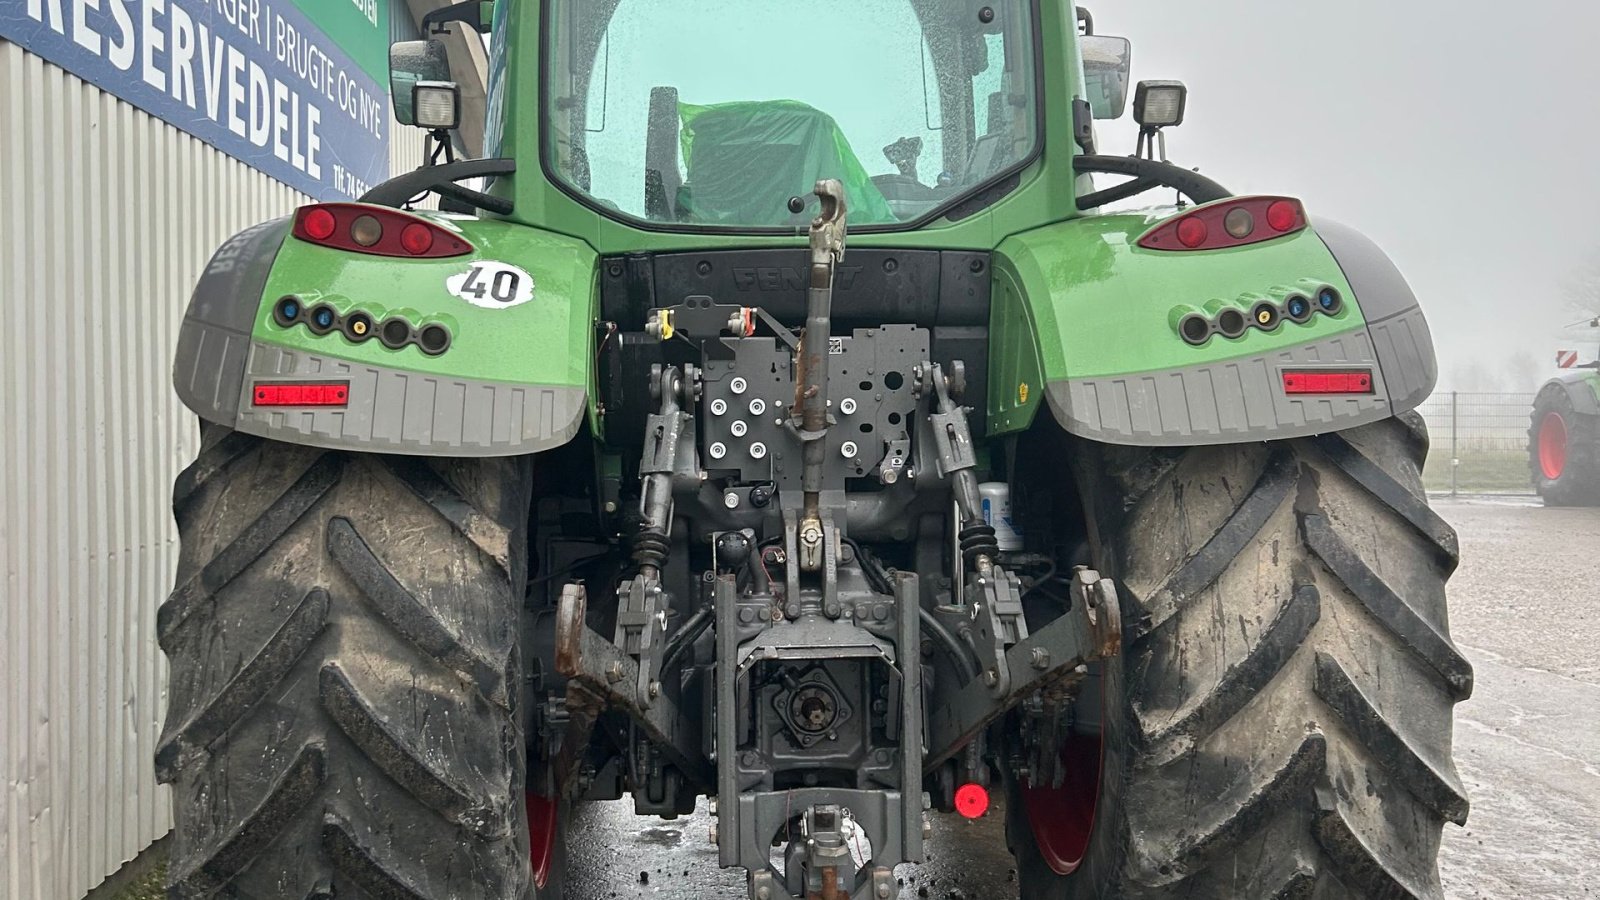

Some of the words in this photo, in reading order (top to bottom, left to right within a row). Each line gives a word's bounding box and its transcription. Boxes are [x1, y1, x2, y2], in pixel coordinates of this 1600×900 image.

[206, 0, 261, 45] GER
[266, 5, 270, 52] I
[276, 14, 335, 102] BRUGTE
[338, 70, 357, 120] OG
[360, 87, 381, 140] NYE
[27, 0, 321, 180] SERVEDELE
[346, 172, 355, 200] 74
[461, 267, 520, 302] 40
[732, 265, 863, 291] FENT
